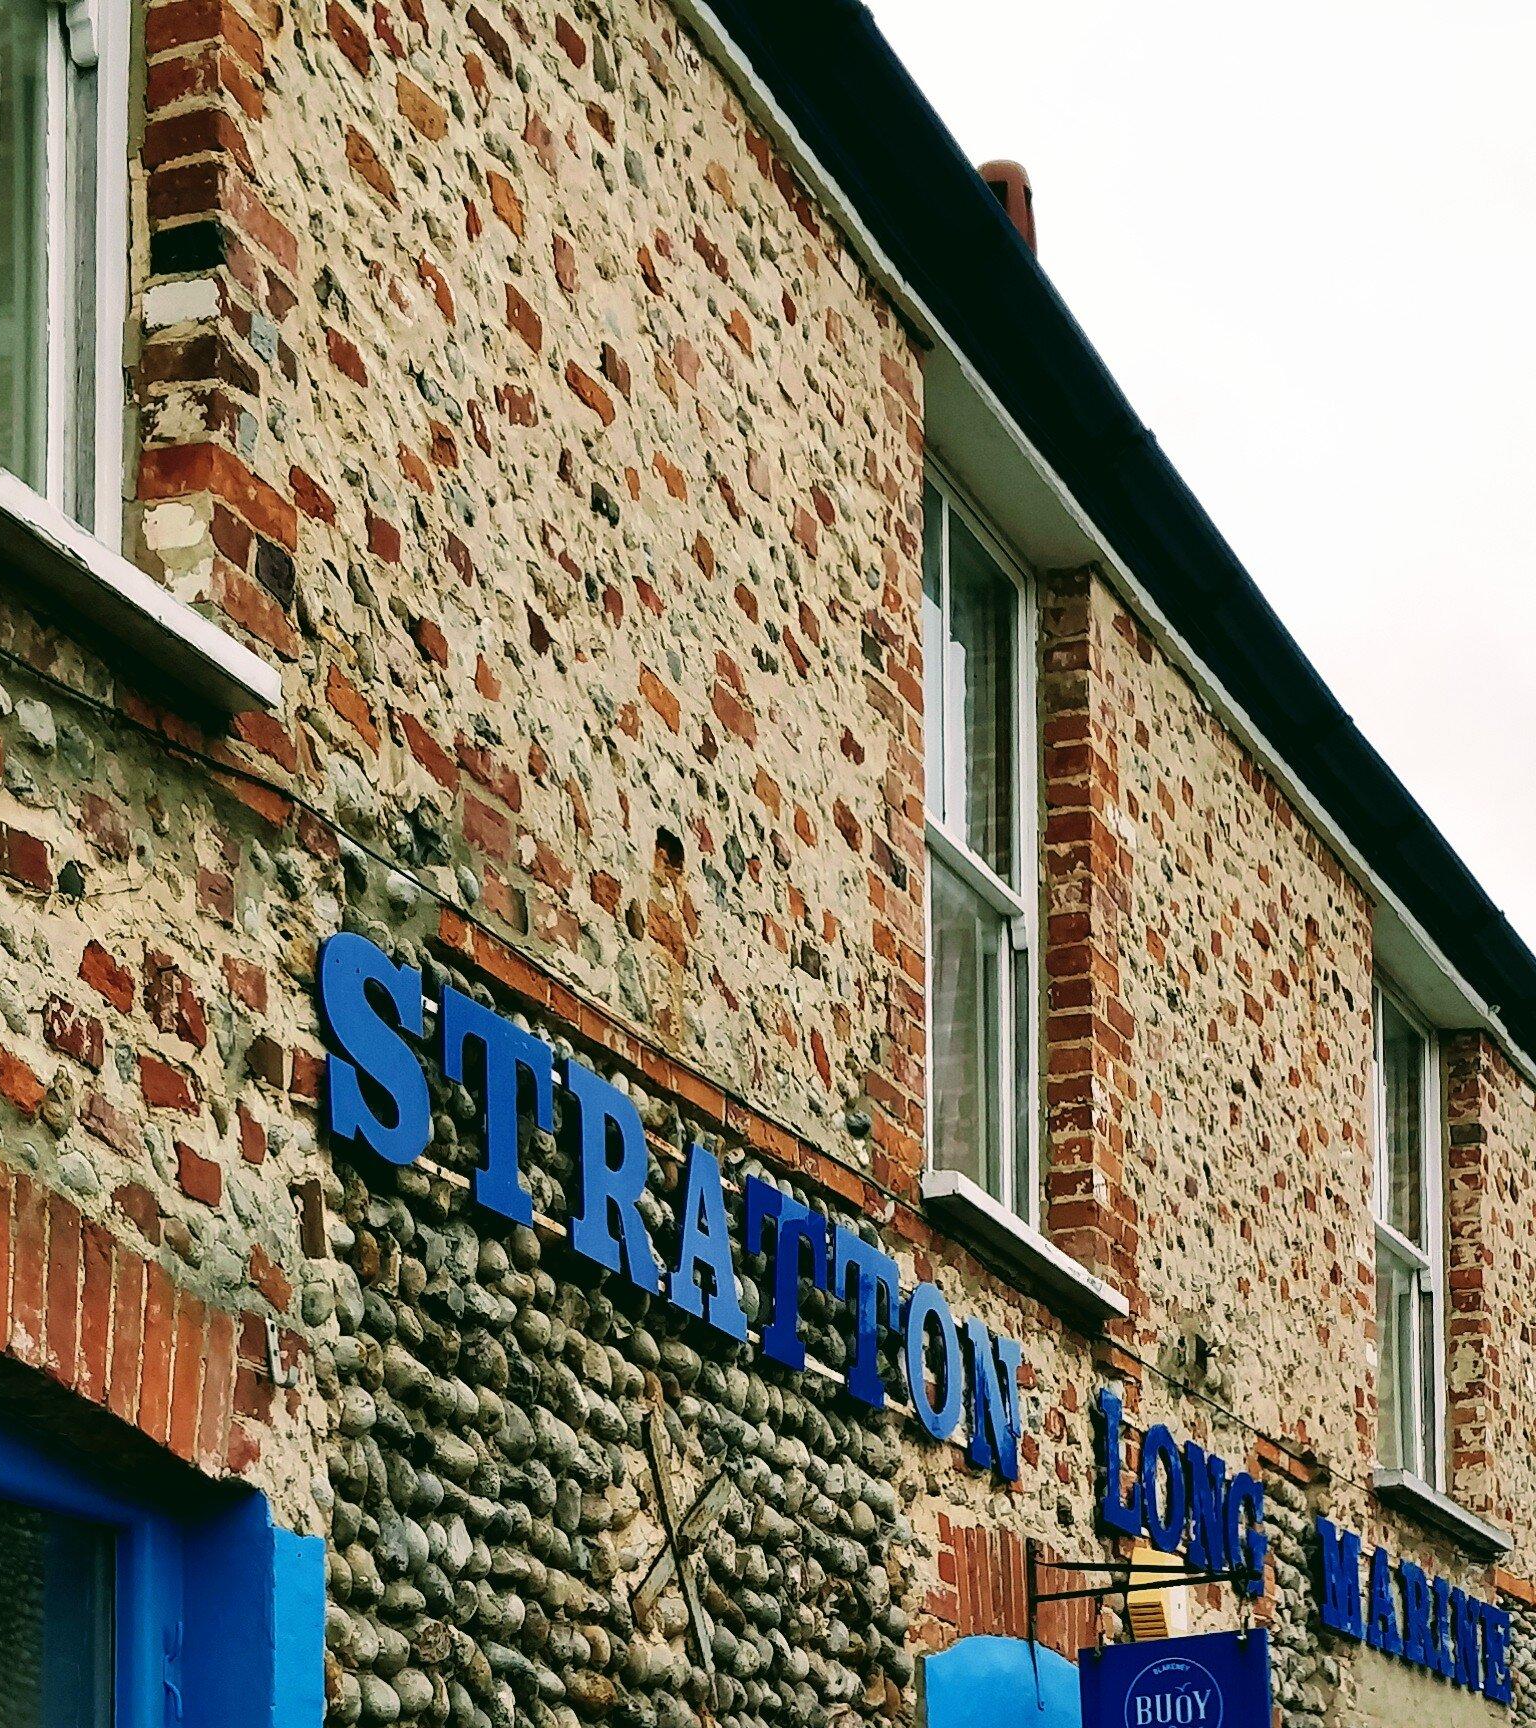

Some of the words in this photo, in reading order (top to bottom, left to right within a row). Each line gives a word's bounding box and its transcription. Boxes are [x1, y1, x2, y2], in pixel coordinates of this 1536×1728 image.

[321, 931, 1023, 1481] STRATTON
[1099, 1386, 1268, 1597] LONG
[1316, 1515, 1513, 1706] MARINE
[1135, 1688, 1212, 1726] BUOY
